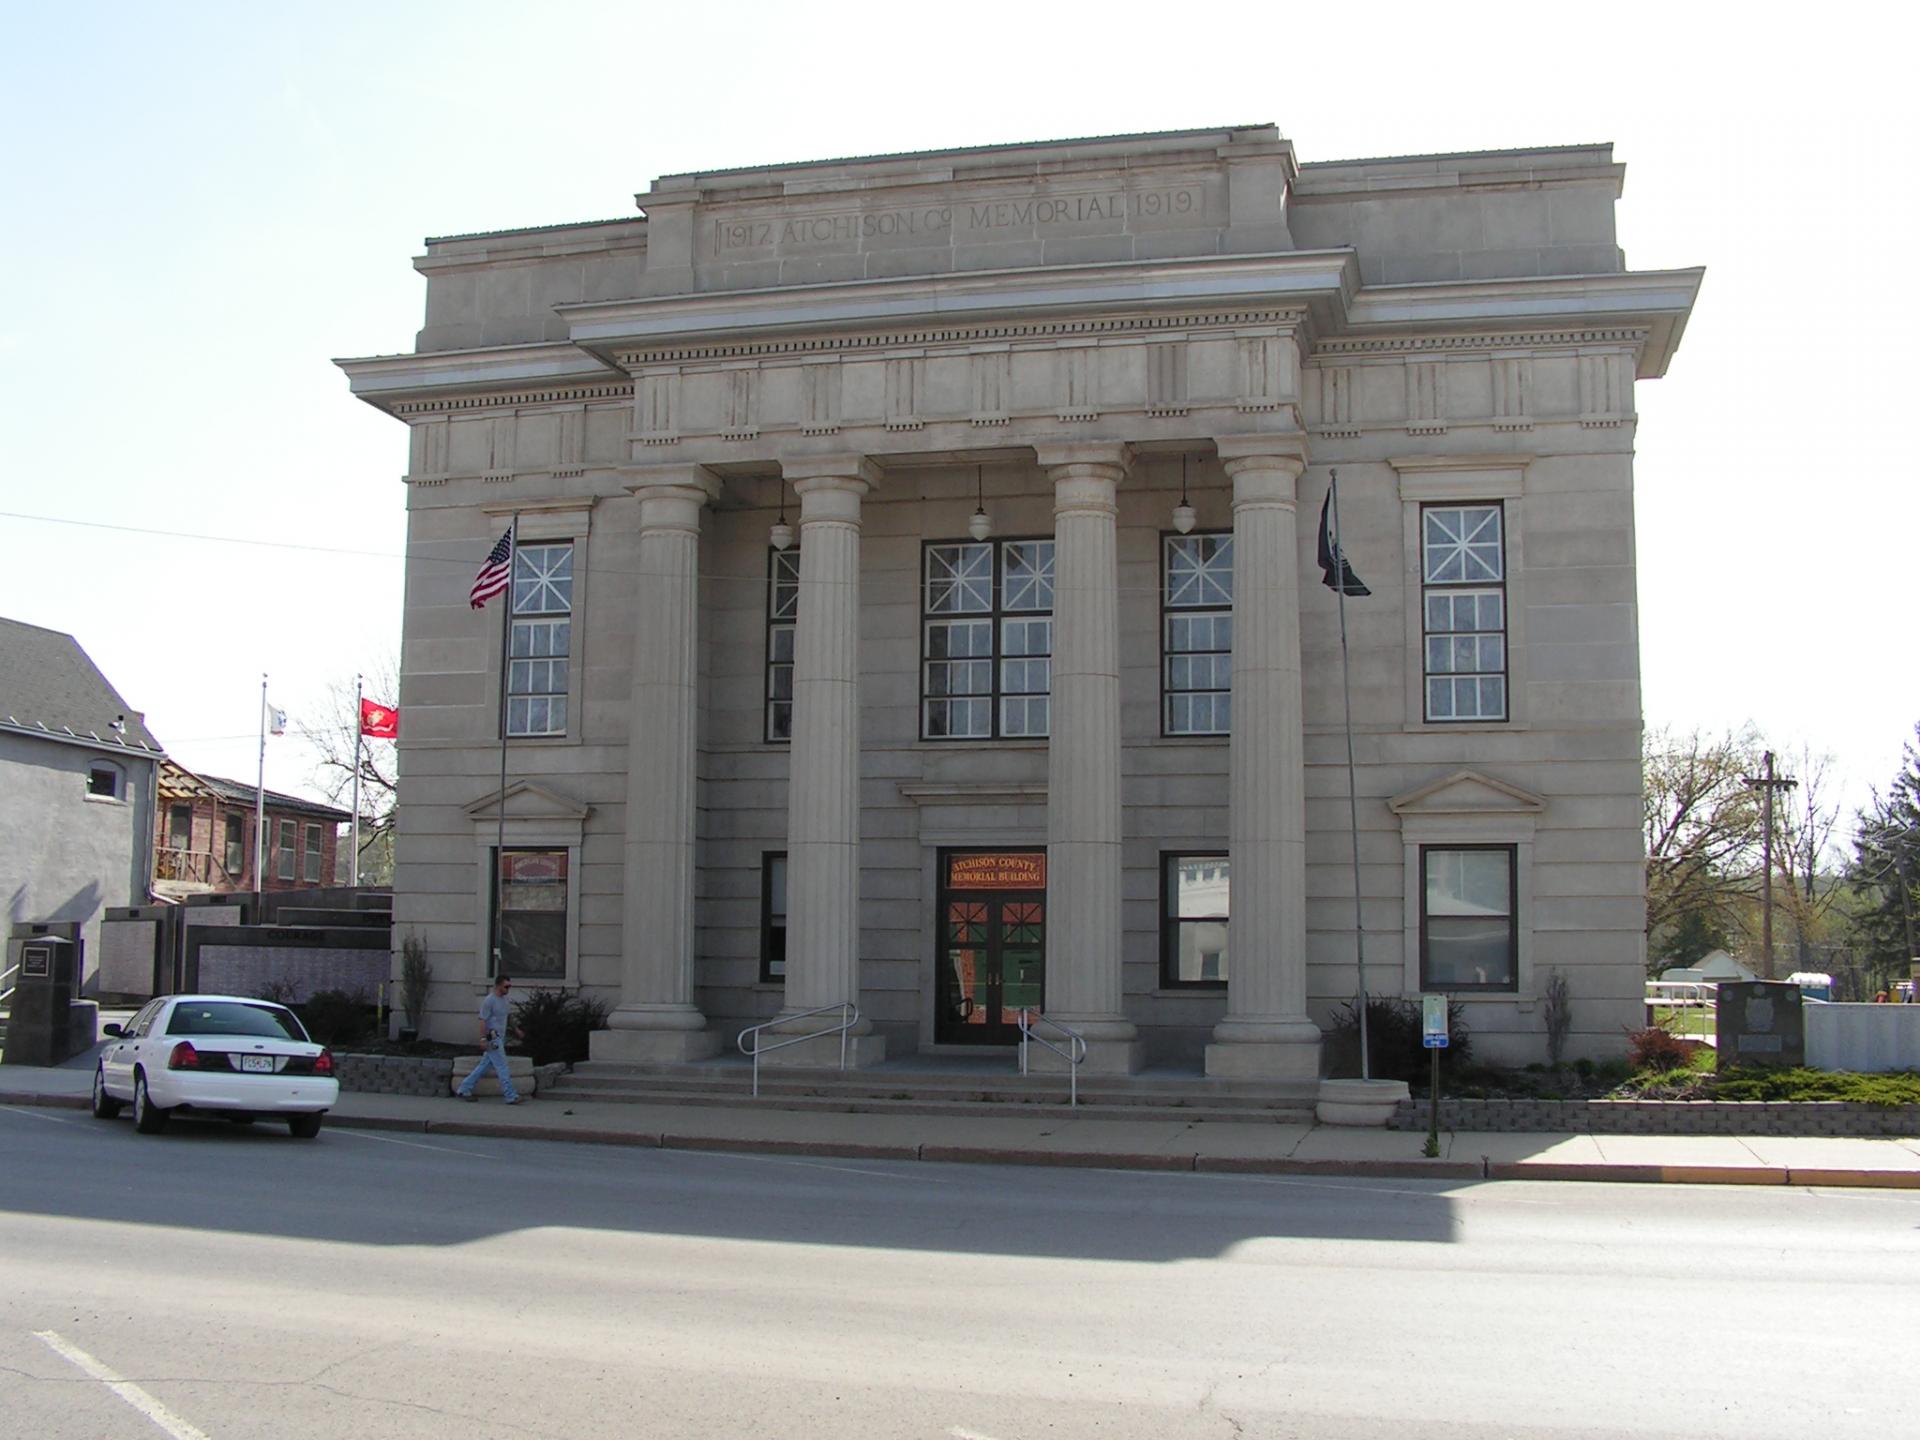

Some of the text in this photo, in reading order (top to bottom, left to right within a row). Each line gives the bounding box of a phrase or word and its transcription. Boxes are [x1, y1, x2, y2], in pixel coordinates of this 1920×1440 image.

[779, 210, 917, 244] ATCHISON
[952, 857, 1037, 872] ATCHISON COUNTY
[951, 872, 1040, 881] MEMORIAL BUILDING
